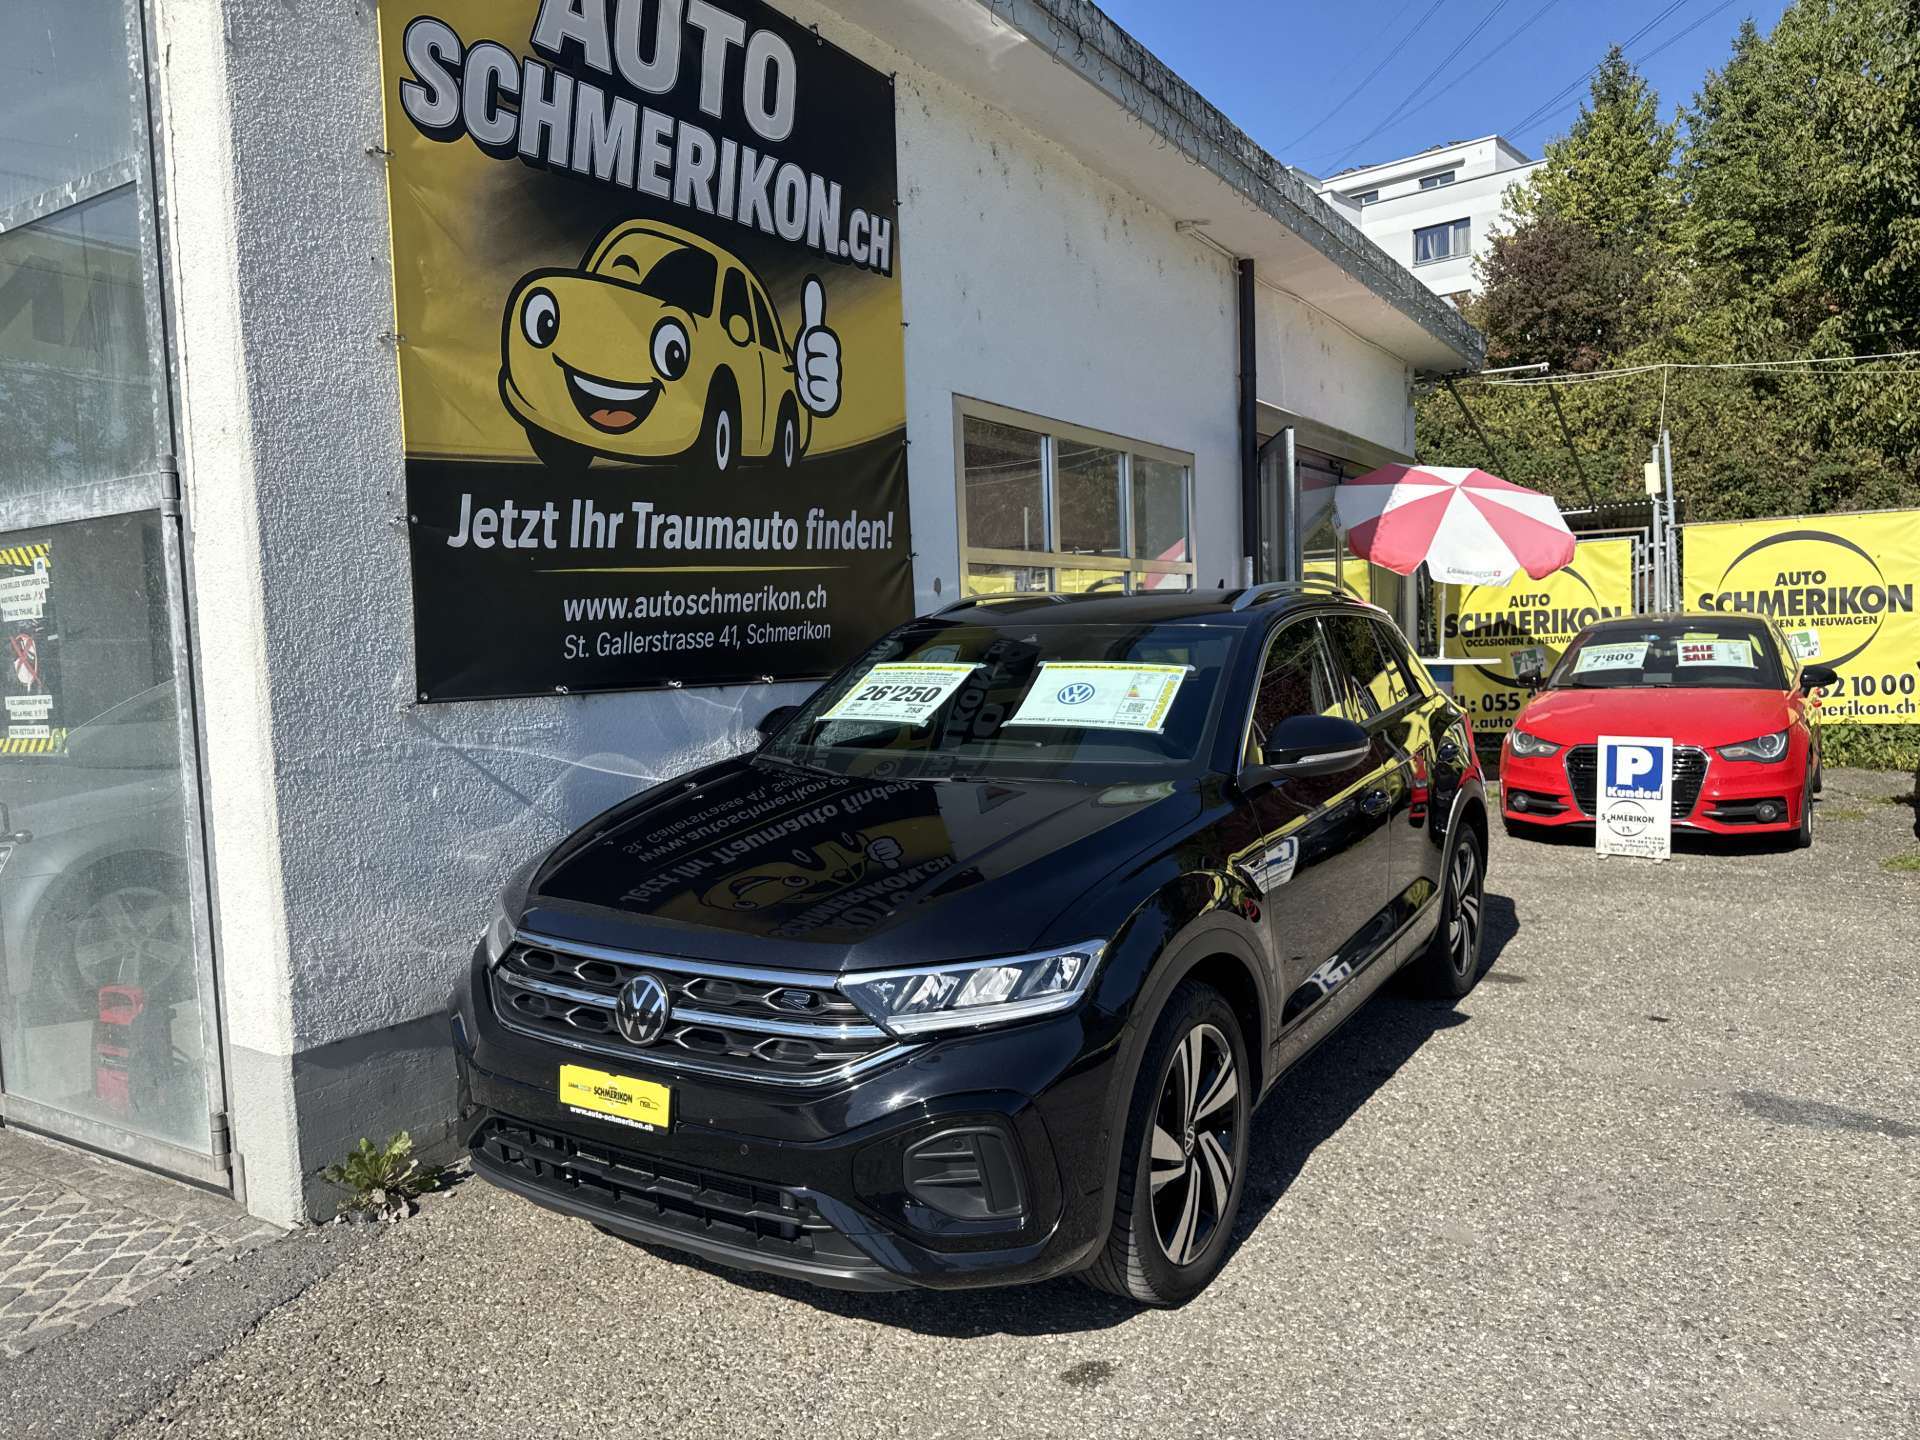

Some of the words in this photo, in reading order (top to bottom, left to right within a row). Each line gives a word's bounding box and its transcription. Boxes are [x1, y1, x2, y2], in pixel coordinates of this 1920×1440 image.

[532, 0, 796, 141] AUTO
[401, 19, 893, 272] SCHMERIKON.CH
[447, 493, 560, 549] Jetzt
[569, 499, 623, 549] Ihr
[632, 502, 798, 550] Traumauto
[806, 508, 894, 550] finden!
[1775, 570, 1827, 587] AUTO
[563, 584, 828, 623] www.autoschmerikon.ch
[1508, 593, 1551, 608] AUTO
[1698, 584, 1914, 617] SCHMERIKON
[1798, 619, 1806, 627] &
[1811, 616, 1878, 627] NEUWAGEN
[563, 637, 589, 660] St.
[597, 628, 715, 656] Gallerstrasse
[719, 625, 741, 650] 41,
[747, 621, 831, 644] Schmerikon
[1466, 637, 1524, 648] OCCASIONEN
[1527, 636, 1535, 645] &
[1682, 644, 1714, 653] SALE
[1593, 652, 1634, 663] 7'800
[1682, 653, 1715, 662] SALE
[855, 685, 943, 703] 26'250
[1851, 675, 1876, 697] 10
[1482, 693, 1520, 712] 055
[1616, 746, 1654, 786] P
[1607, 786, 1663, 800] Kunden
[593, 1085, 633, 1104] SCHMERIKON
[569, 1106, 654, 1132] www.auto-schmerikon.ch
